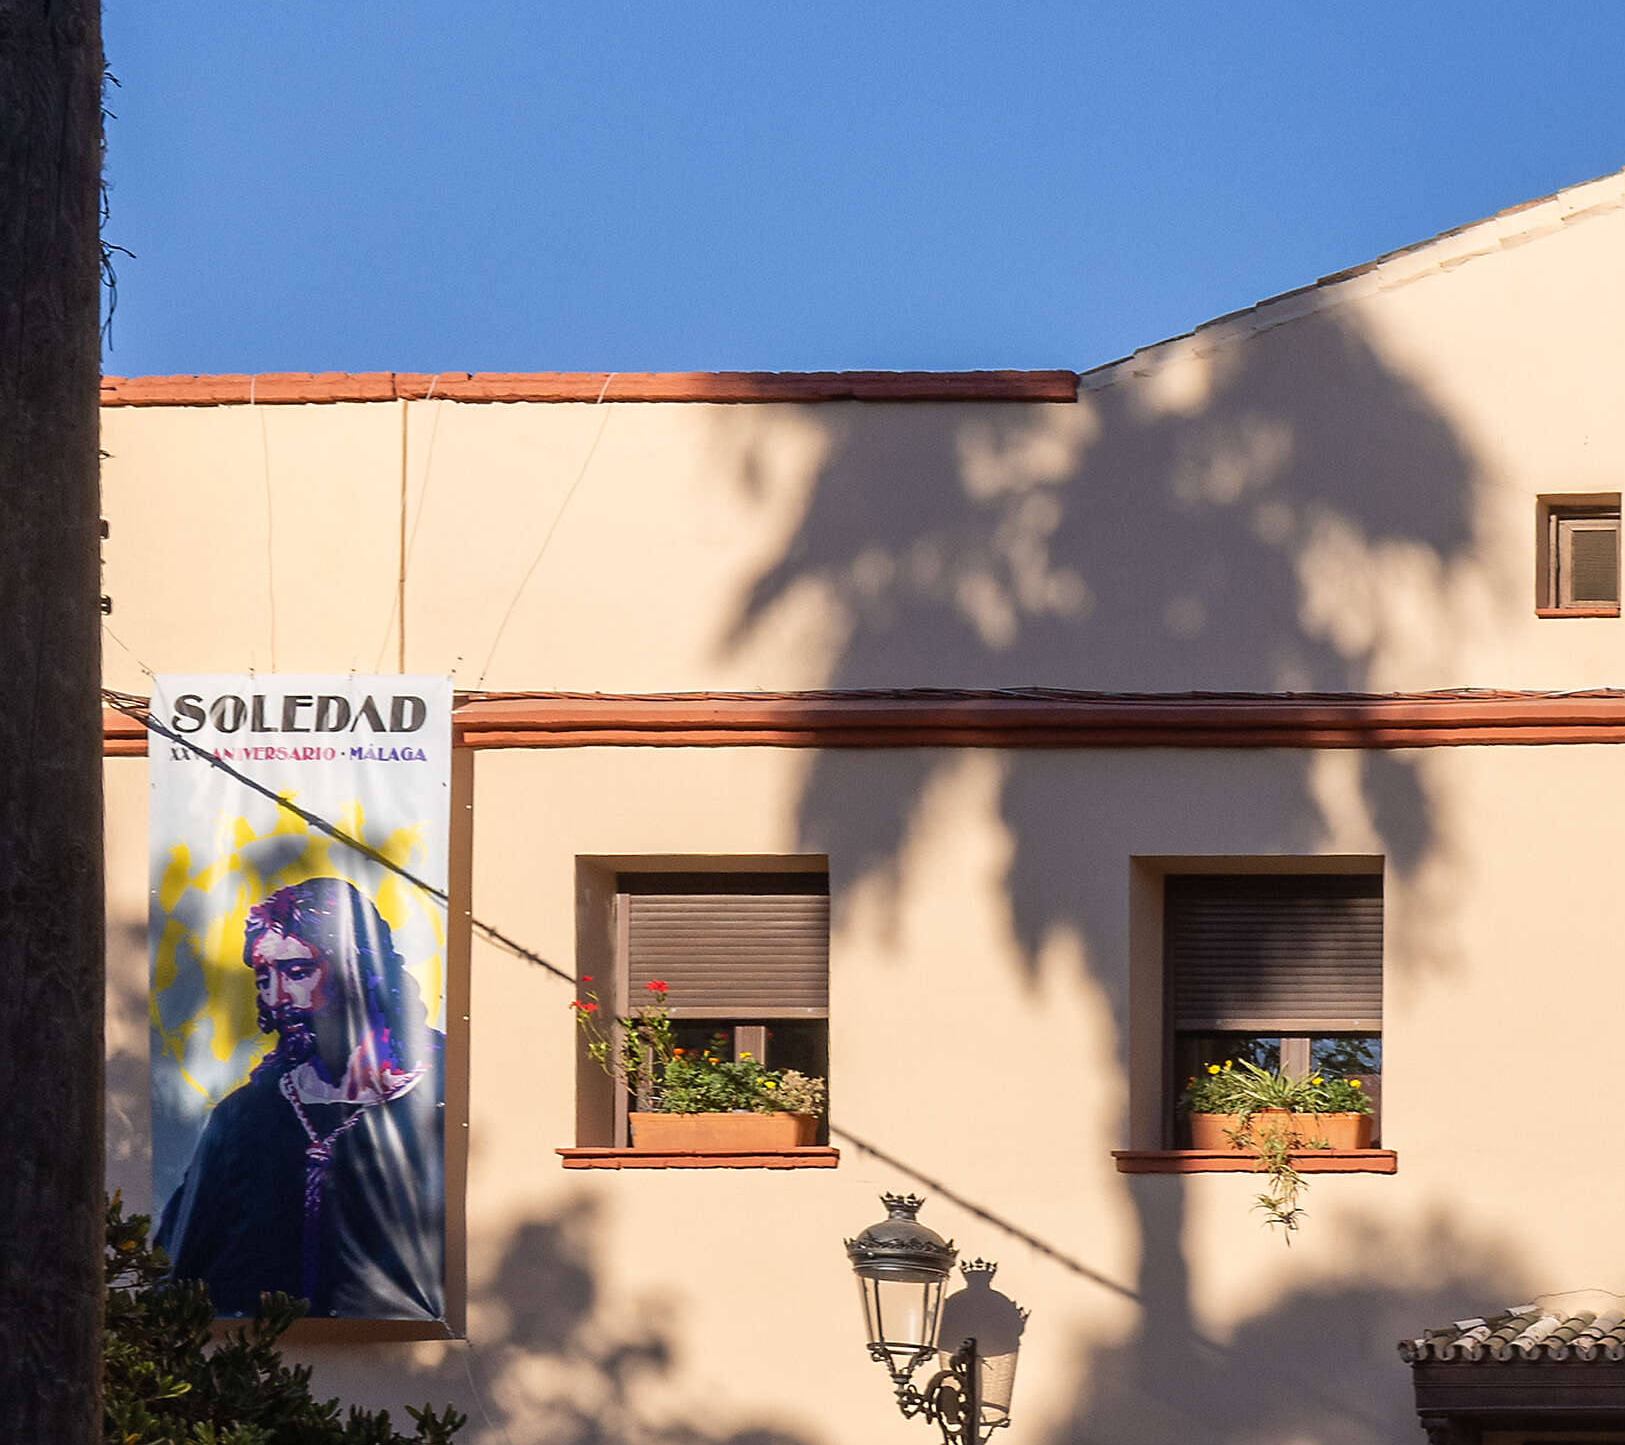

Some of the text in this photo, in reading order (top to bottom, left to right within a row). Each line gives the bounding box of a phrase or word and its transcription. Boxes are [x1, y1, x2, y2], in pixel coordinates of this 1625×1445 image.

[171, 694, 428, 734] SOLEDAD
[170, 746, 203, 761] XX
[350, 743, 428, 762] MÁLAGA
